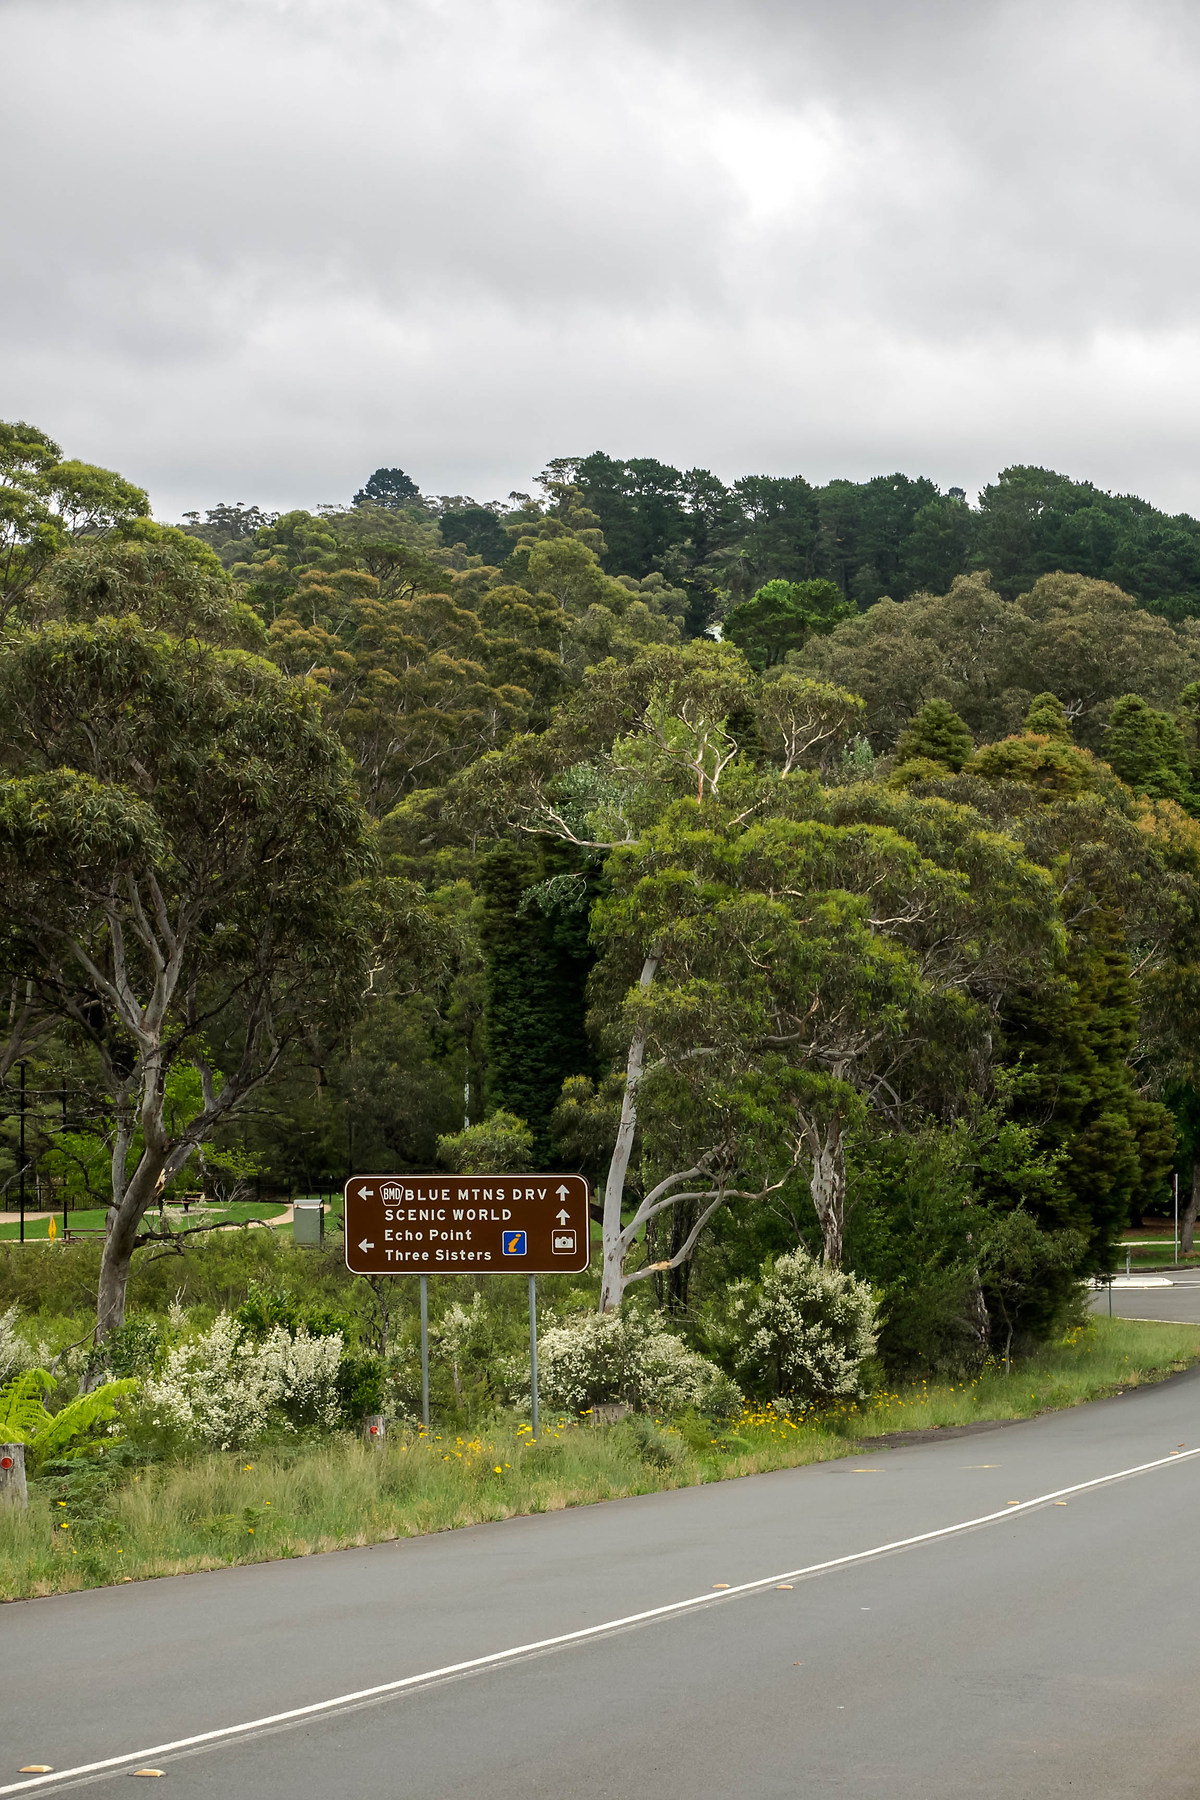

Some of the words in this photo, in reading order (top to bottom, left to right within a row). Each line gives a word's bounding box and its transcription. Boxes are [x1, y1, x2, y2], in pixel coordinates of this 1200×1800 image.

[383, 1187, 401, 1200] BMD
[404, 1189, 451, 1201] BLUE
[458, 1189, 505, 1201] MTNS
[512, 1188, 547, 1201] DRV
[384, 1209, 446, 1221] SCENIC
[452, 1209, 512, 1221] WORLD
[384, 1229, 423, 1241] Echo
[429, 1229, 472, 1241] Point
[384, 1249, 430, 1261] Three
[435, 1248, 492, 1261] Sisters
